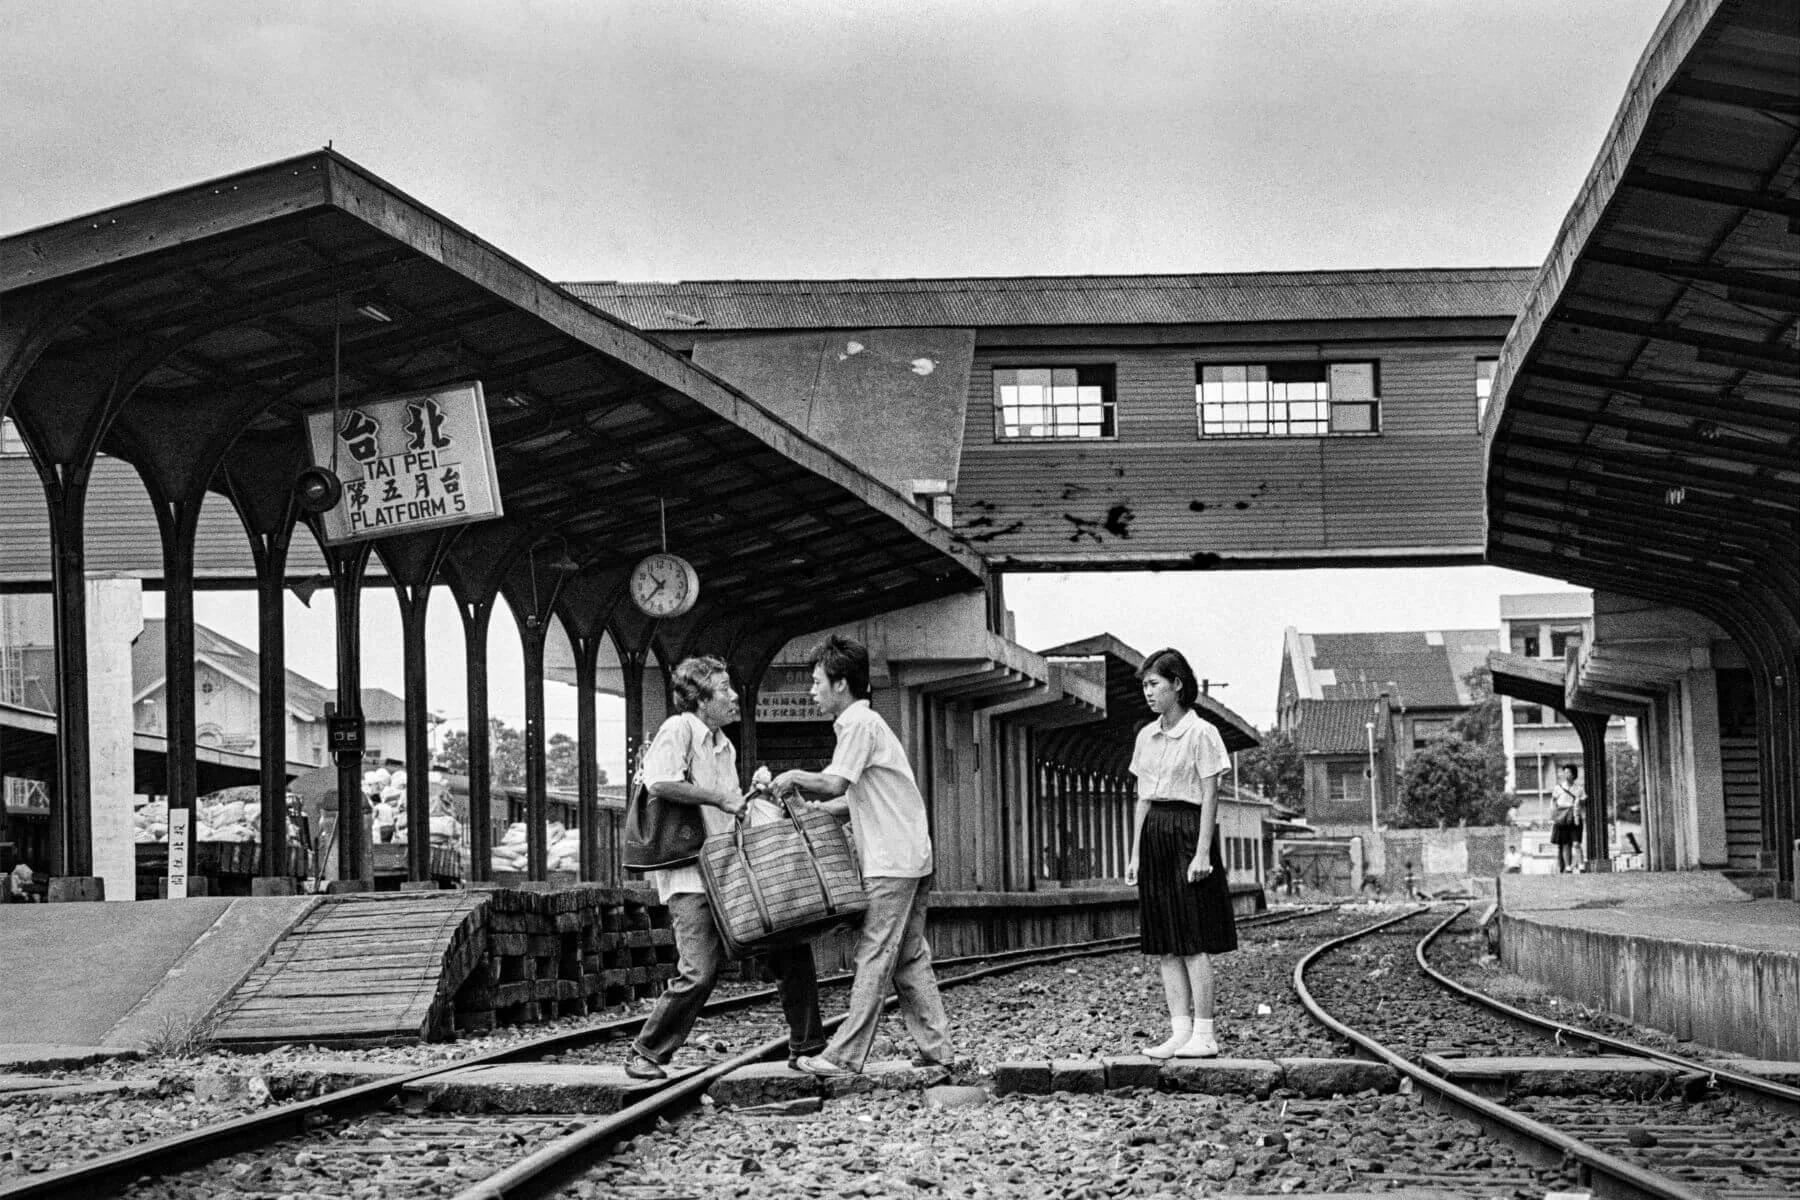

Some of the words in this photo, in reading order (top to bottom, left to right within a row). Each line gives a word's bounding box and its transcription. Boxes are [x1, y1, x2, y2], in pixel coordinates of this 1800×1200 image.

[338, 399, 450, 462] 台北
[364, 458, 396, 480] TAI
[404, 450, 437, 473] PEI
[347, 467, 460, 511] 第五月台
[350, 497, 446, 530] PLATFORM
[453, 494, 466, 511] 5
